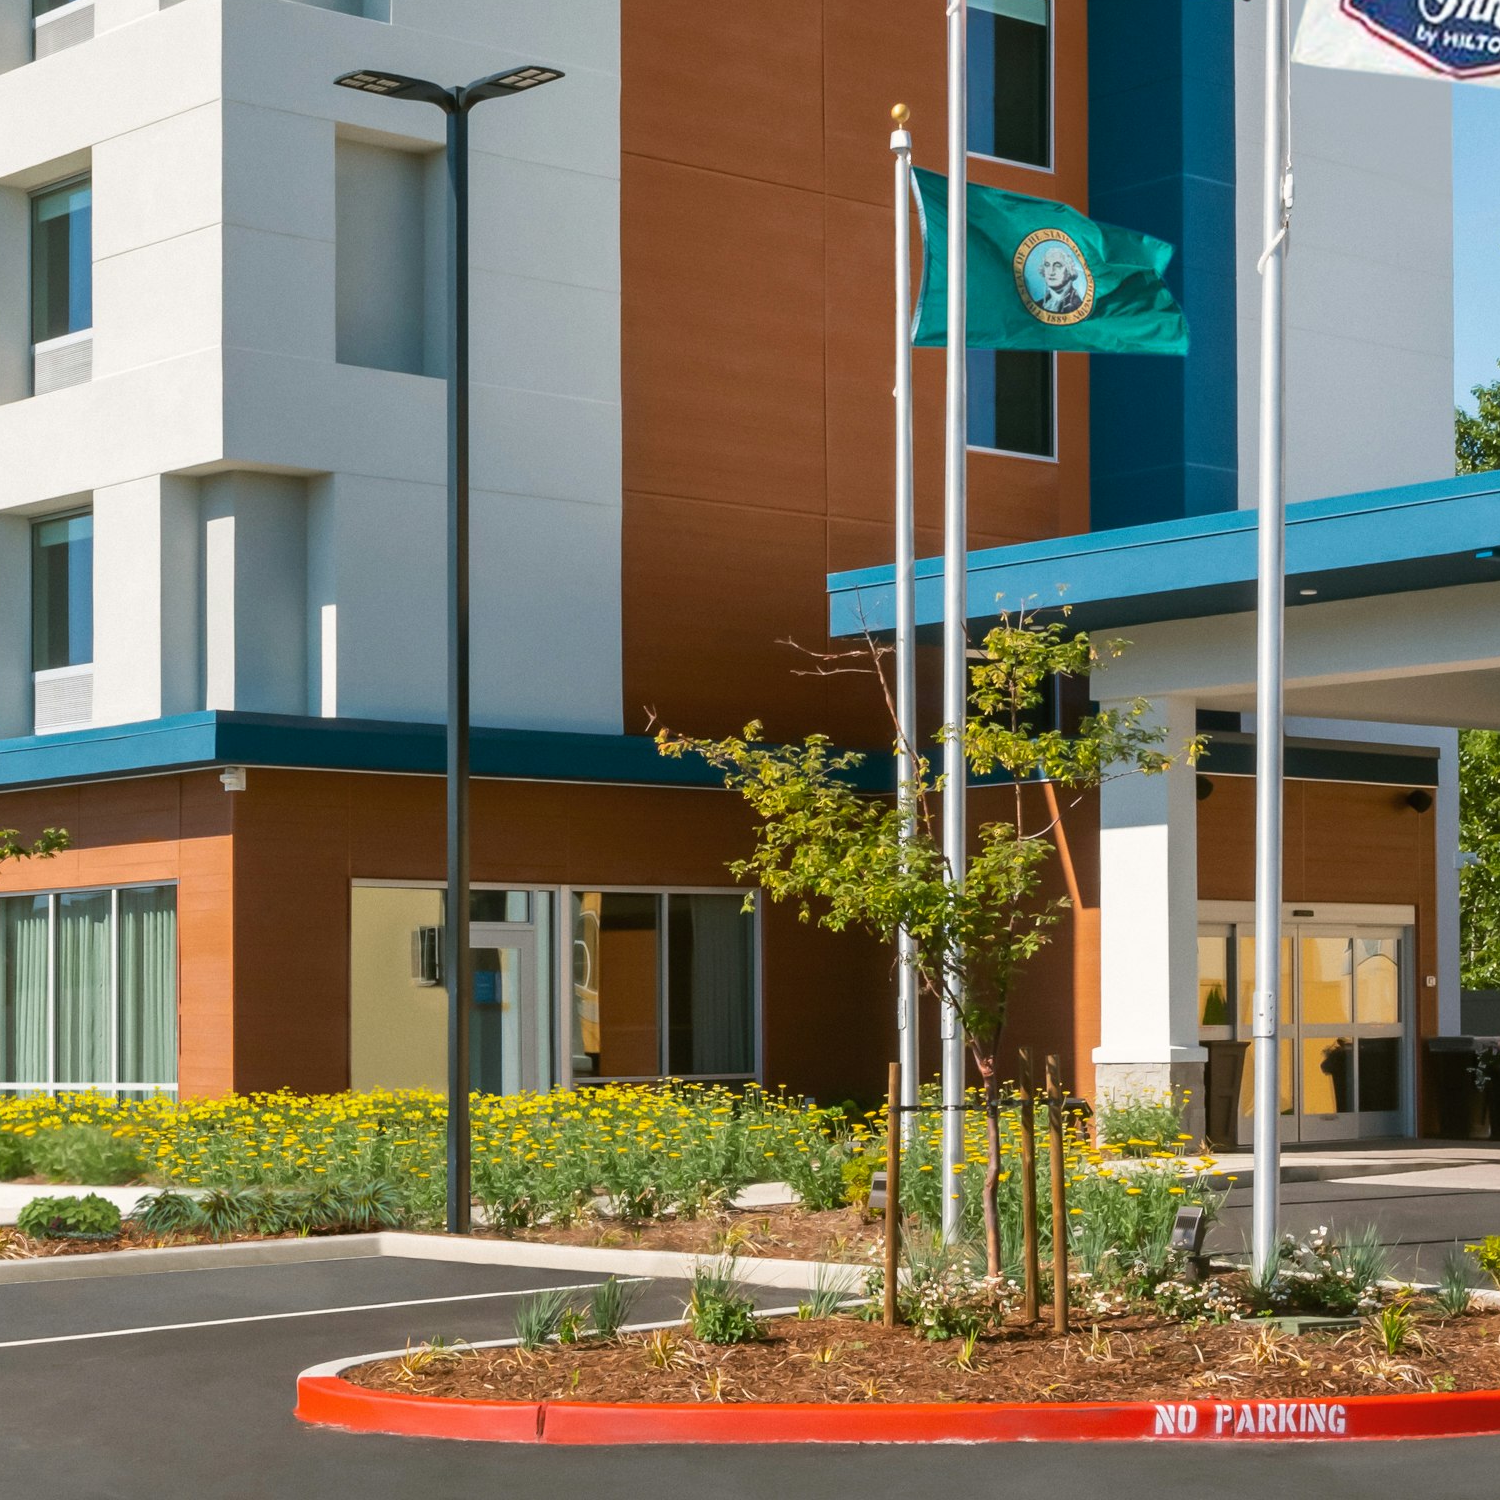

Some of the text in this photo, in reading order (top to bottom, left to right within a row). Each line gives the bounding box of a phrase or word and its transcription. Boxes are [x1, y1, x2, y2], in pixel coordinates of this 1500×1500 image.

[1415, 25, 1437, 43] by
[1015, 252, 1025, 265] OF
[1023, 234, 1040, 249] THE
[1046, 314, 1067, 324] 1889
[1154, 1403, 1346, 1435] NO PARKING
